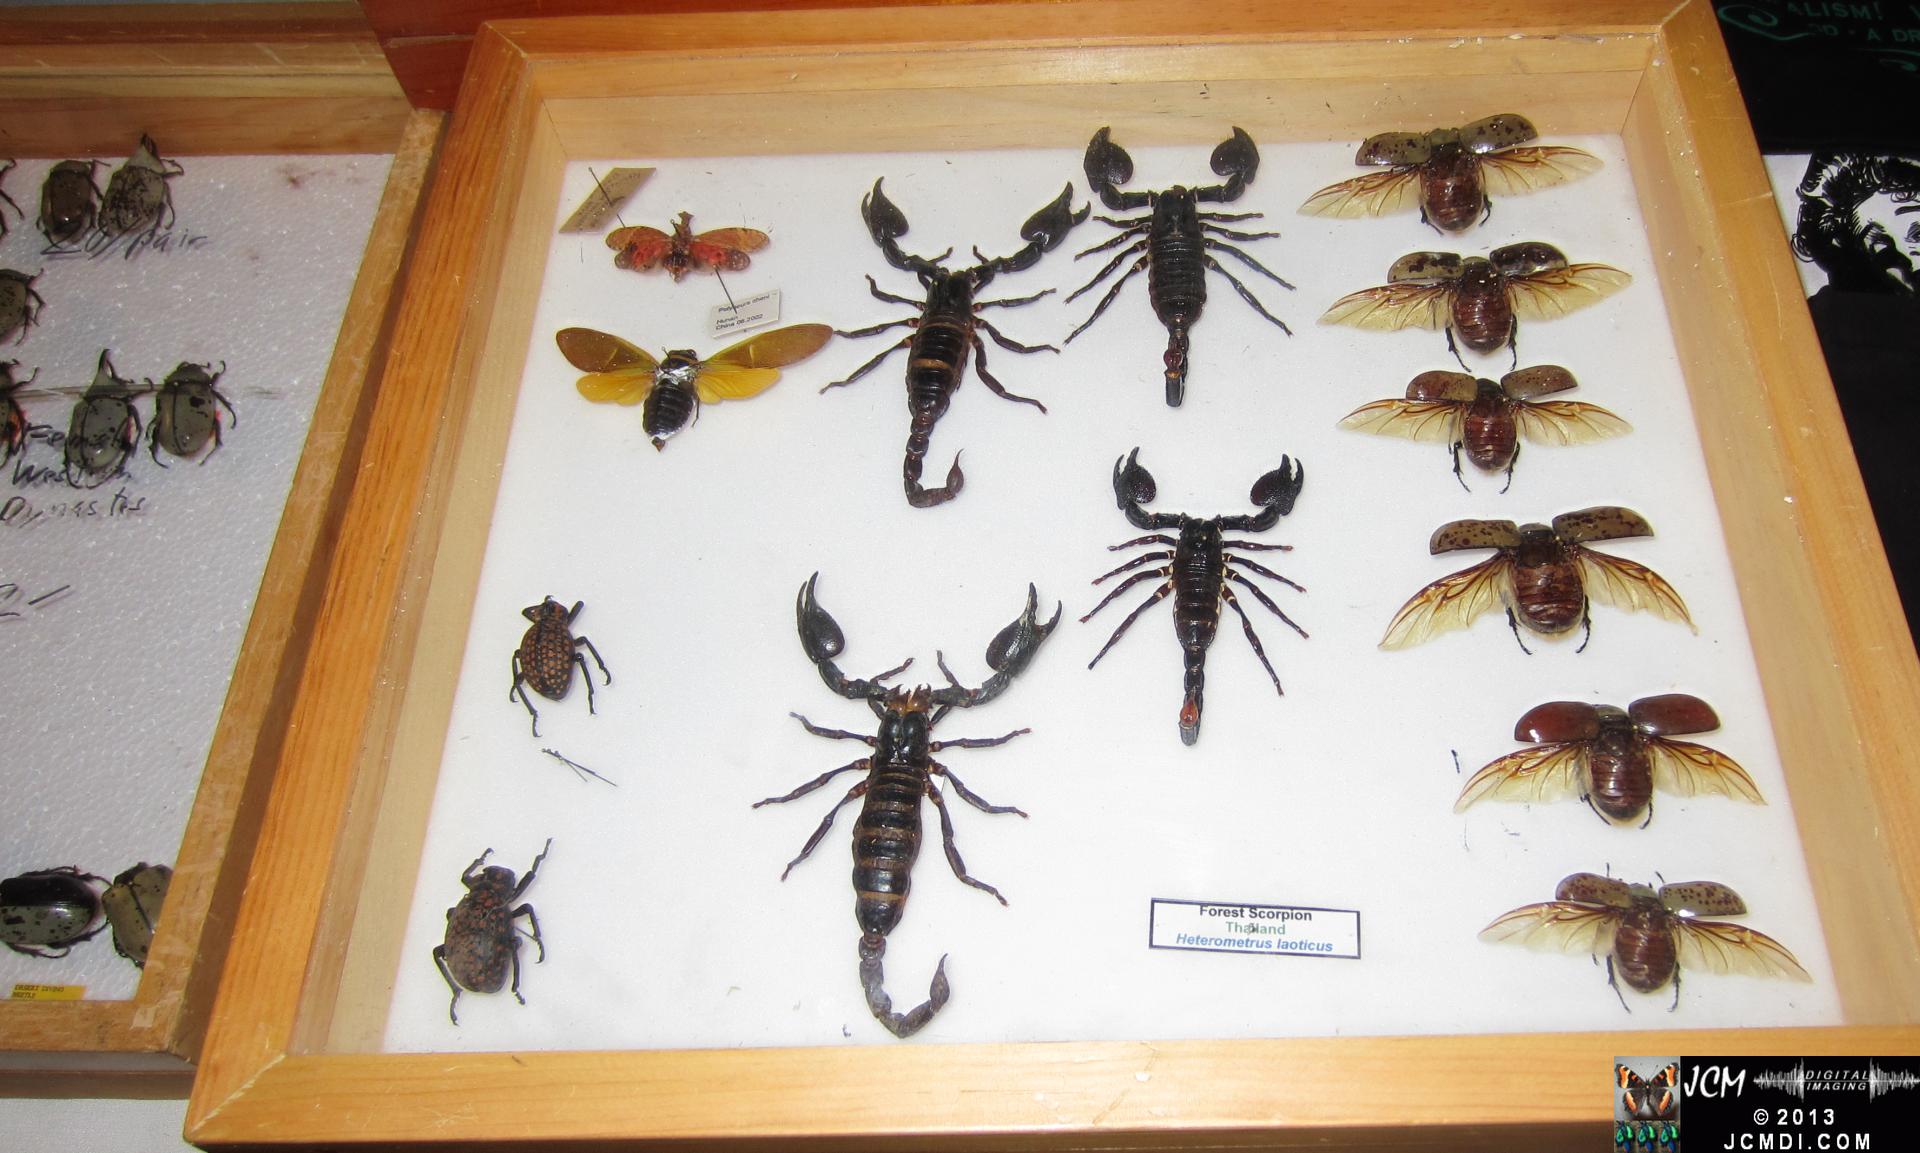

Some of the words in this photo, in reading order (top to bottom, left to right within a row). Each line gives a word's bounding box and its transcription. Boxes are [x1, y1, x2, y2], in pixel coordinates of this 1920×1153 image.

[718, 301, 751, 313] Polyeura
[716, 322, 736, 330] China
[1199, 904, 1244, 919] Forest
[1248, 907, 1312, 922] Scorpion
[1225, 921, 1286, 935] Thaland
[1176, 933, 1273, 949] Heterometrus
[1276, 938, 1334, 952] laoticus
